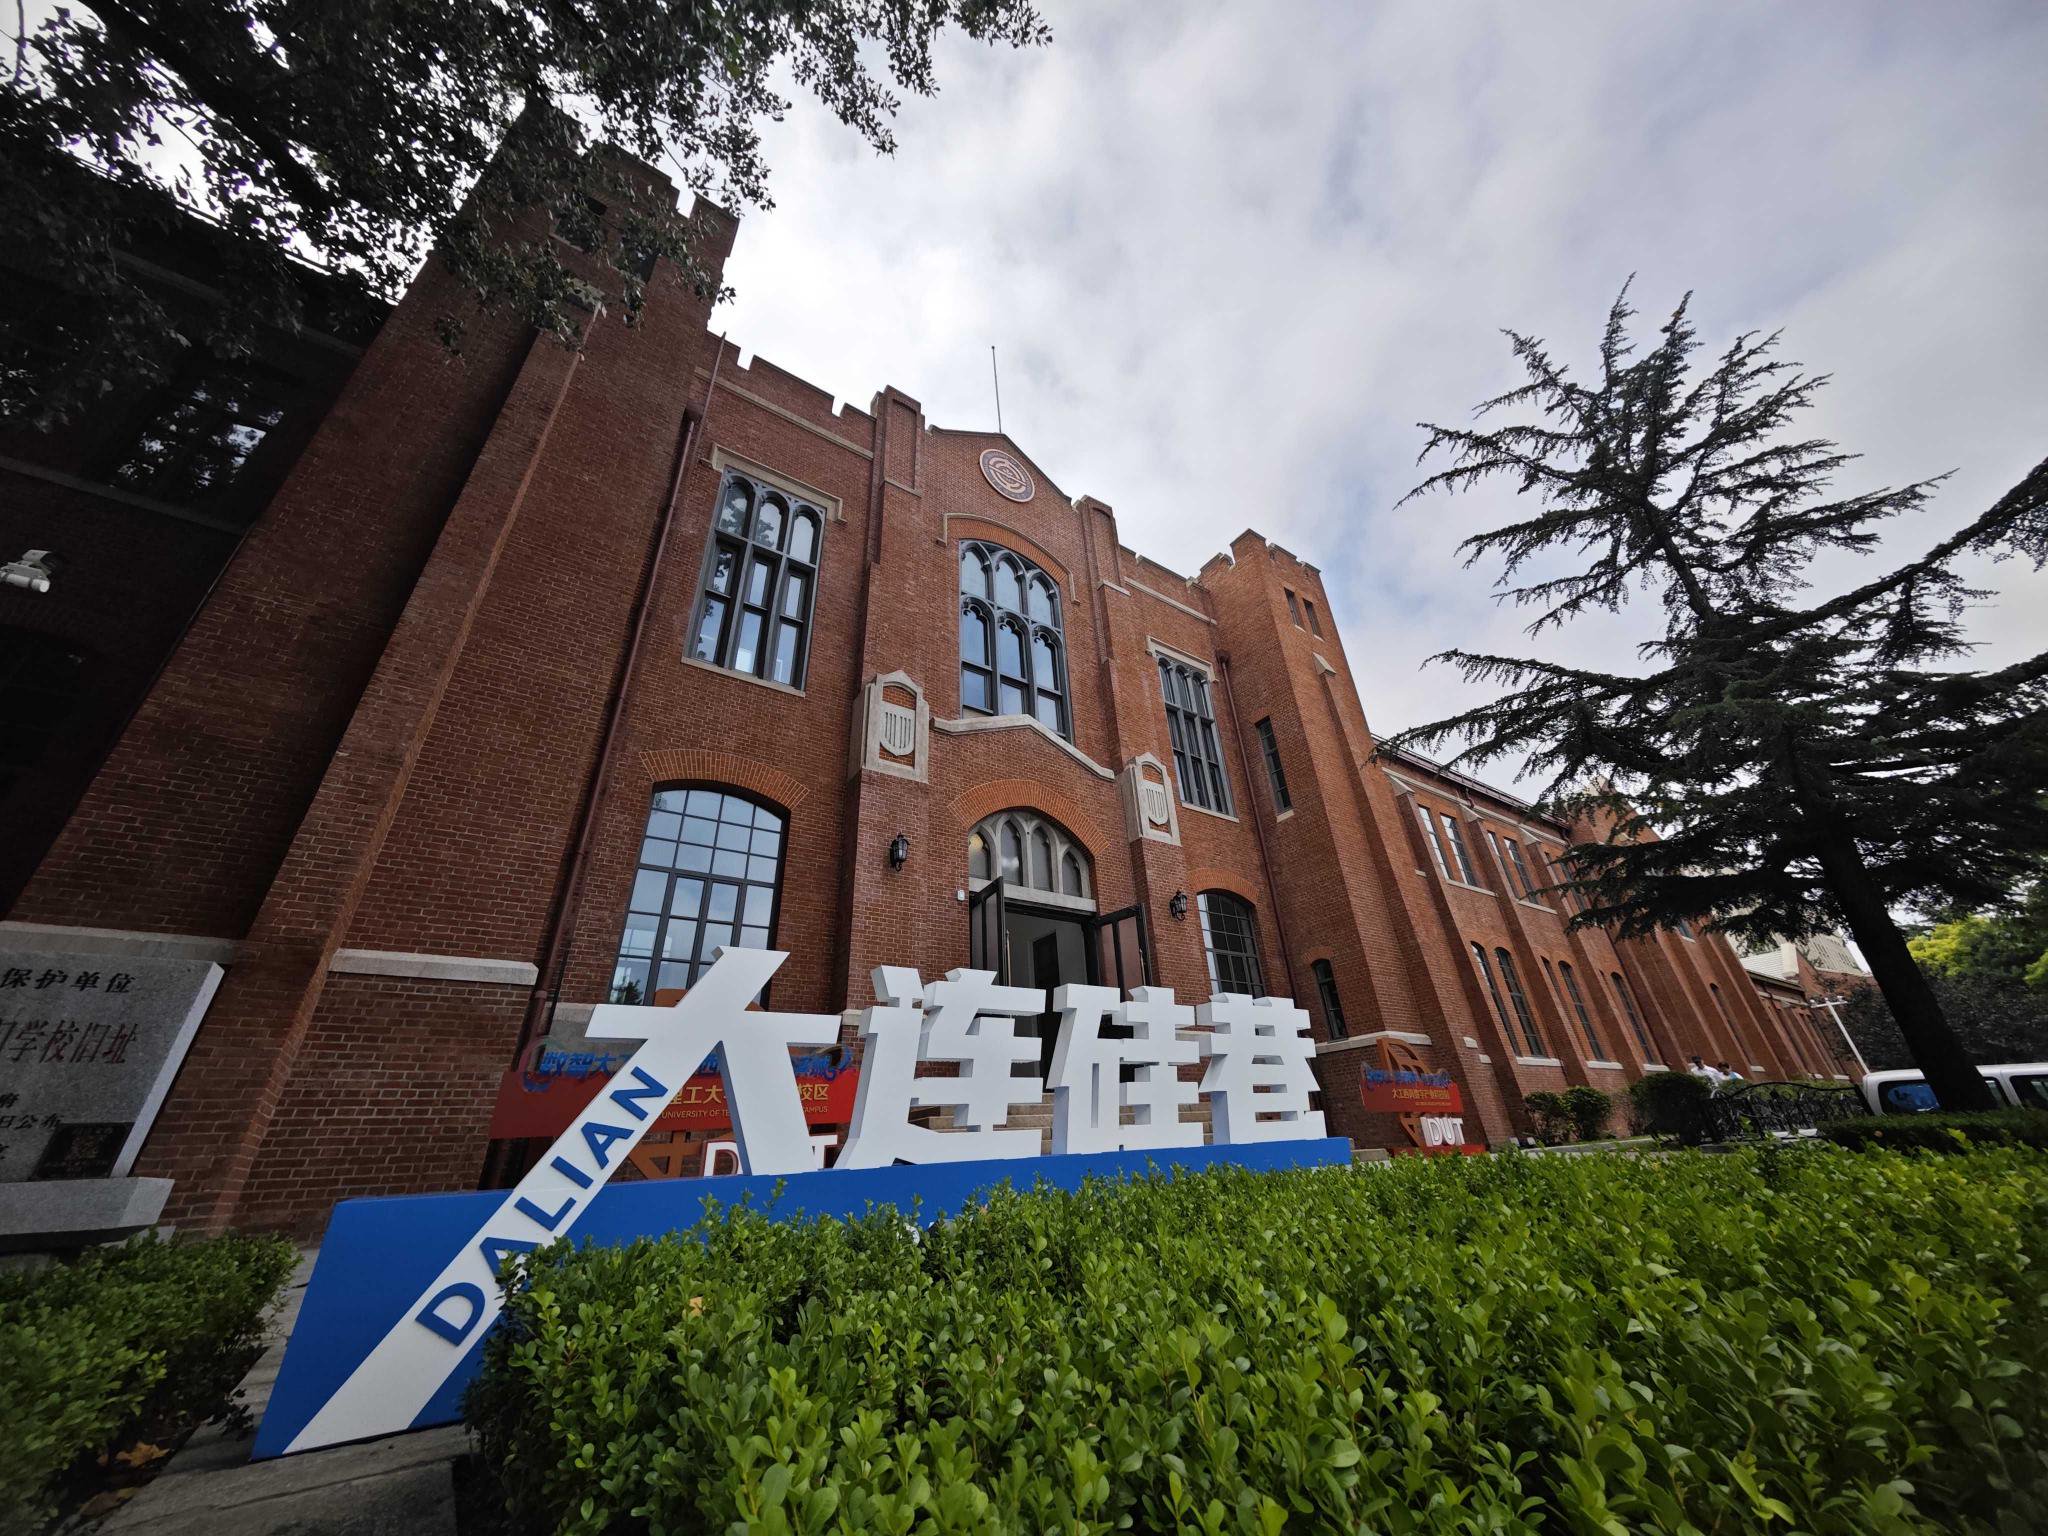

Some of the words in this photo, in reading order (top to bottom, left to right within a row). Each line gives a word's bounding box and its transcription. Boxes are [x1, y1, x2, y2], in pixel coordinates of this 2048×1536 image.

[0, 967, 136, 993] 保护单位
[661, 1110, 708, 1119] UNIVERSITY
[709, 1109, 720, 1117] OF
[803, 1105, 830, 1114] AMPUS
[1420, 1115, 1467, 1147] DUT
[415, 1066, 669, 1347] DALIAN
